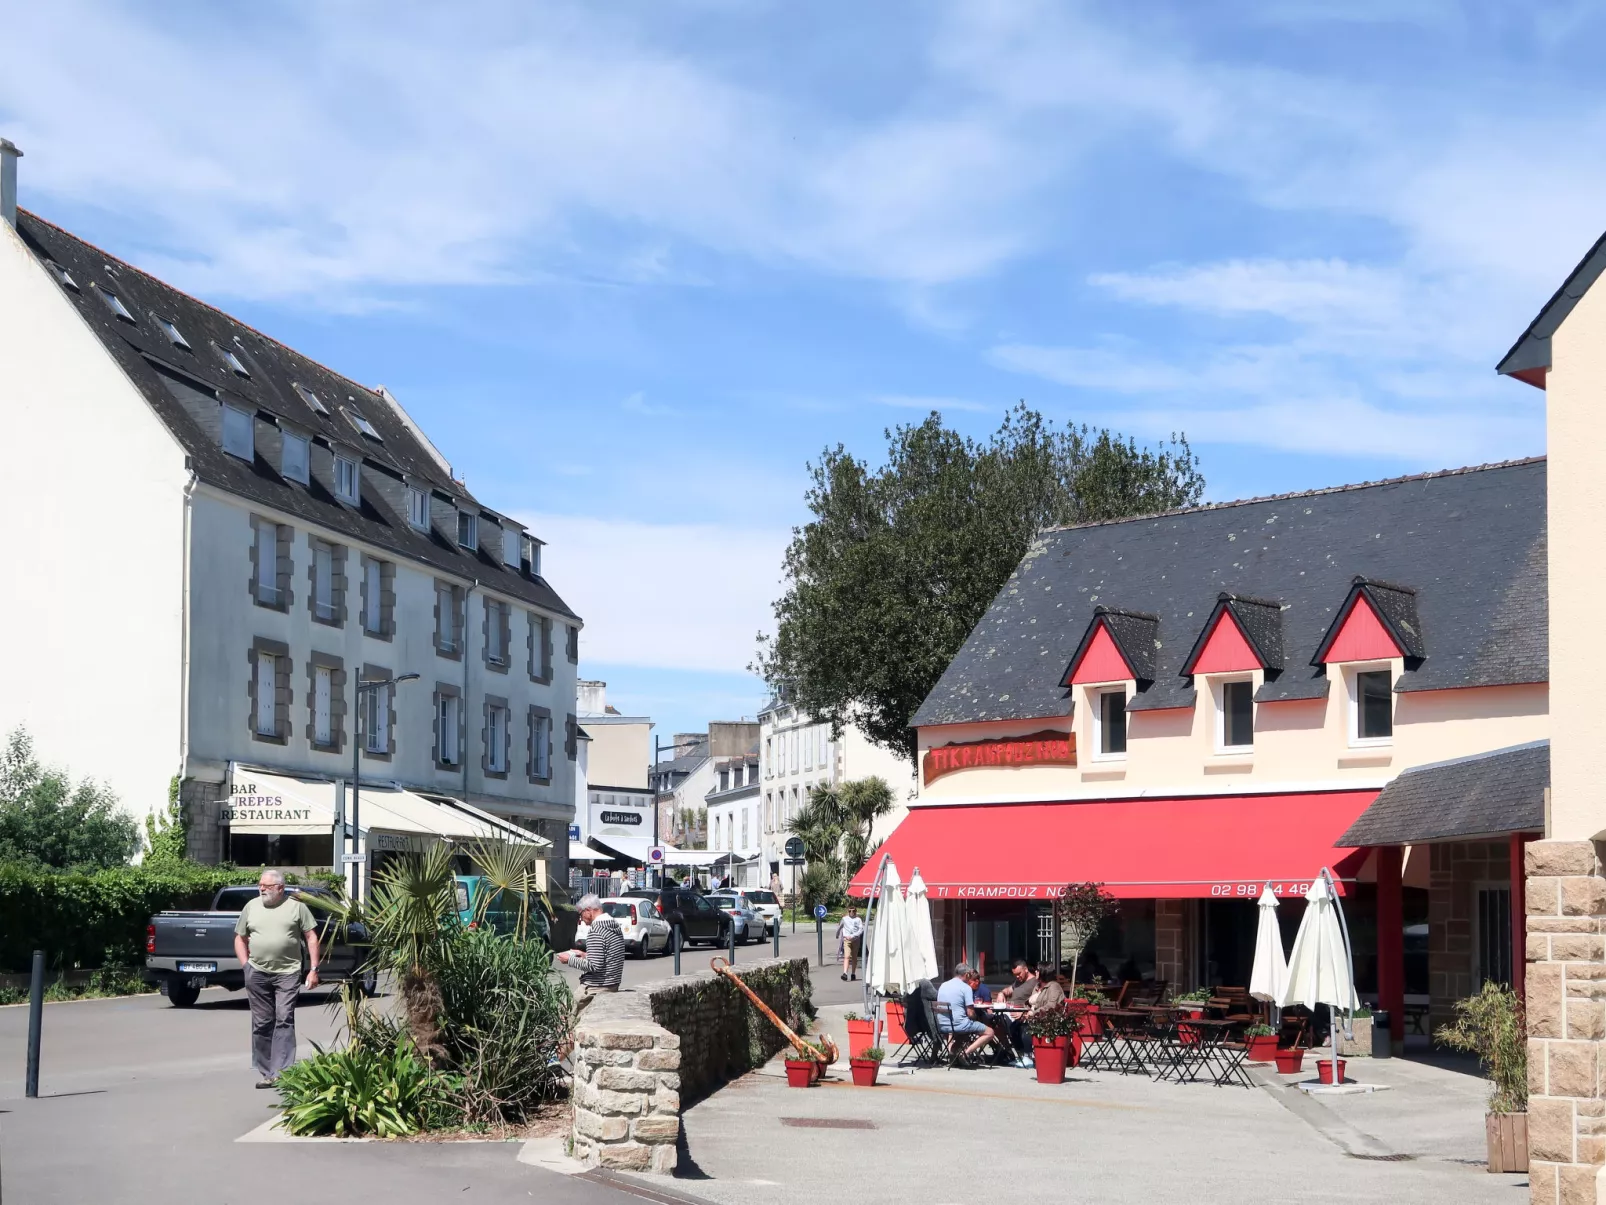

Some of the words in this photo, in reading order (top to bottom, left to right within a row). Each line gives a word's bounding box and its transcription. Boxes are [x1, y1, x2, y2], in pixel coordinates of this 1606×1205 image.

[231, 784, 257, 794] BAR
[235, 793, 282, 806] RÊPES
[221, 810, 311, 820] RESTAURANT
[937, 886, 949, 897] TI
[957, 886, 1038, 897] KRAMPOUZ
[1211, 884, 1232, 896] 02
[1236, 884, 1257, 896] 98
[1263, 884, 1283, 896] 4
[1288, 883, 1309, 895] 48
